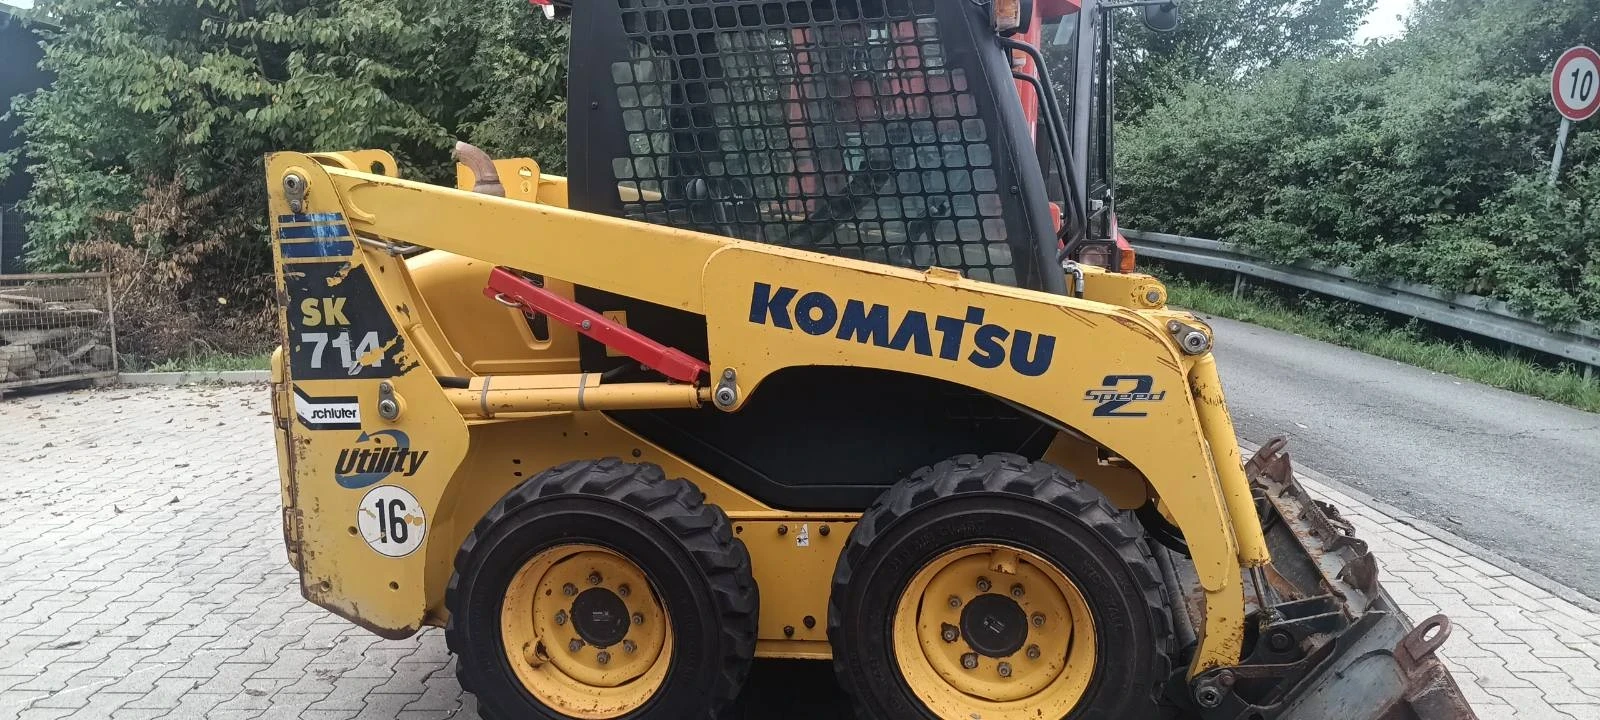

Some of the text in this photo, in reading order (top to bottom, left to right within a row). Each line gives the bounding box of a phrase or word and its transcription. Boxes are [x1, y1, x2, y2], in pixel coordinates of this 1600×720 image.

[1570, 68, 1593, 102] 10
[300, 297, 351, 327] SK
[748, 281, 1057, 377] KOMATSU
[301, 331, 385, 369] 714
[1083, 389, 1166, 404] Speed
[1092, 374, 1153, 417] 2
[334, 446, 429, 477] Utility
[375, 498, 409, 544] 16
